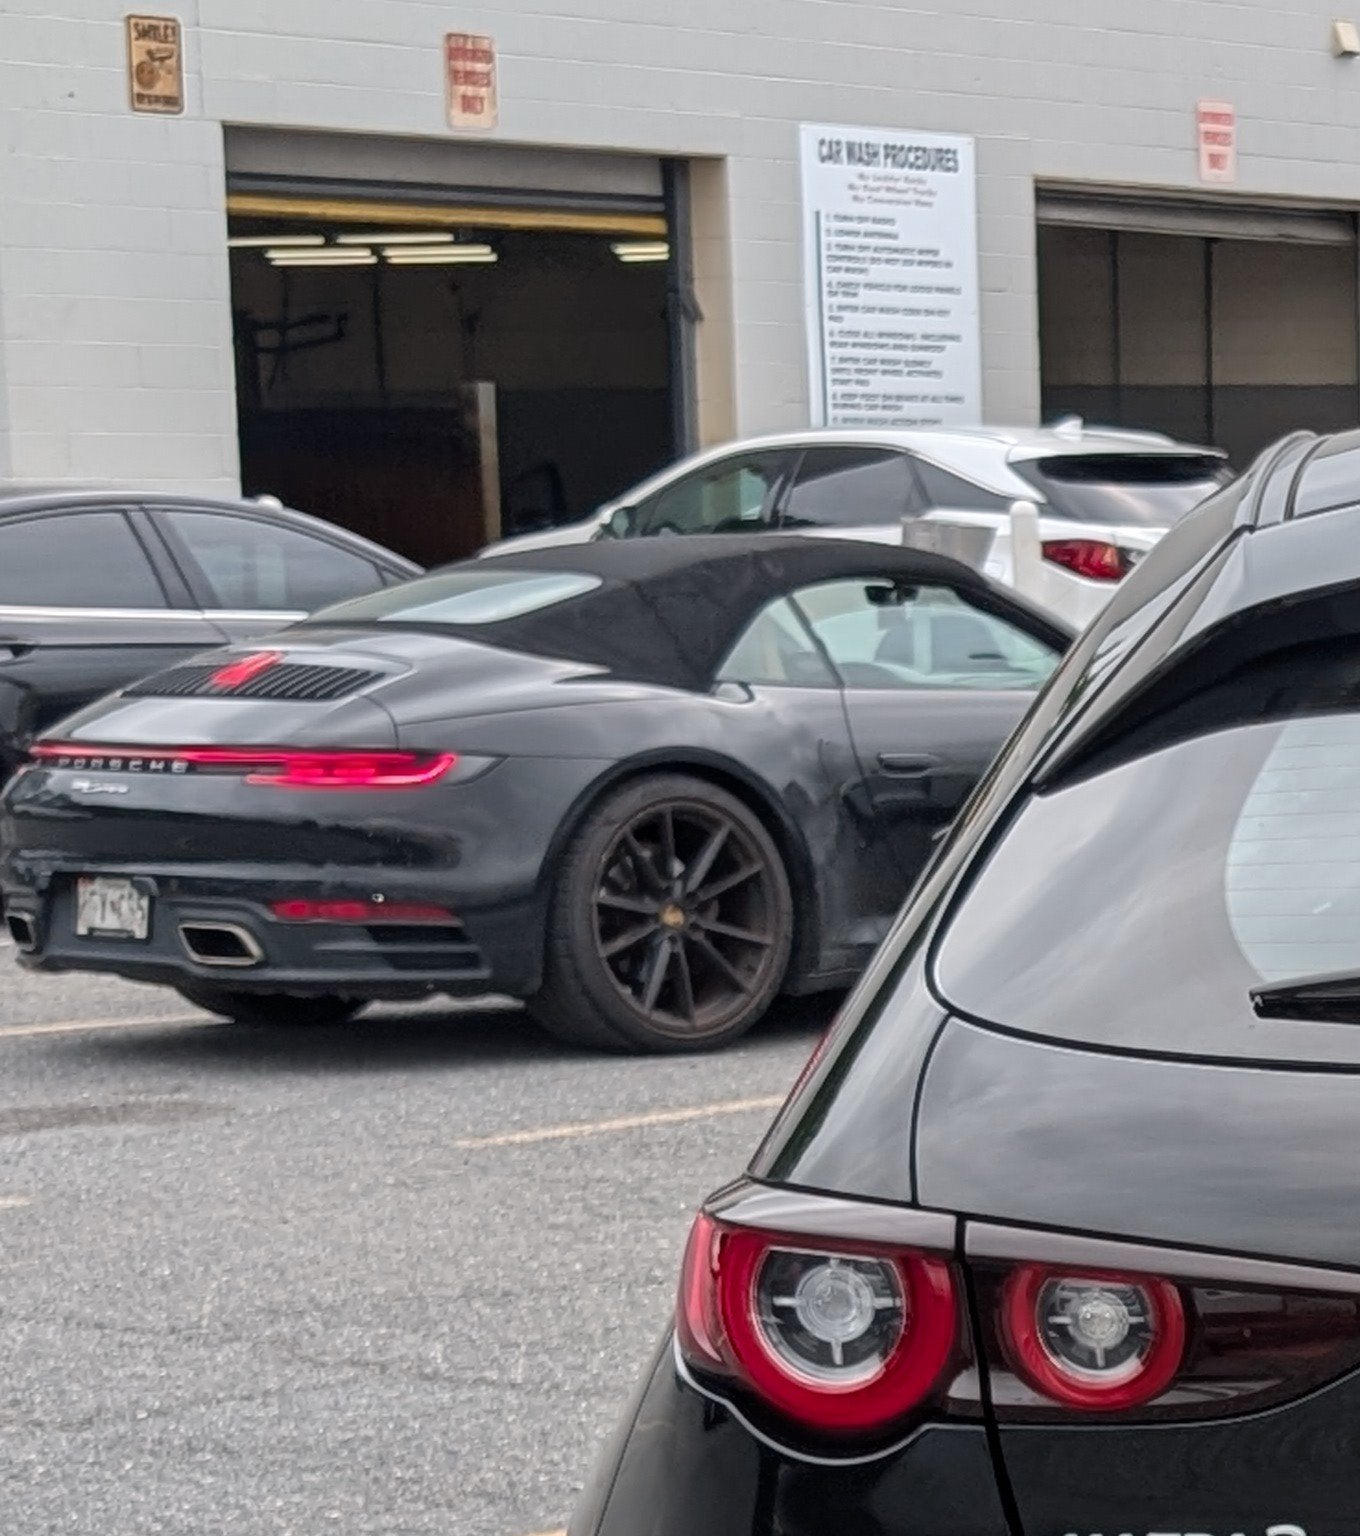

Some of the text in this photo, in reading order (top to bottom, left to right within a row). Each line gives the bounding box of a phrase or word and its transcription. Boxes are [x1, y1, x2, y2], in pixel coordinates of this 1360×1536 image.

[818, 138, 959, 174] CAR WASH PROCEDURES
